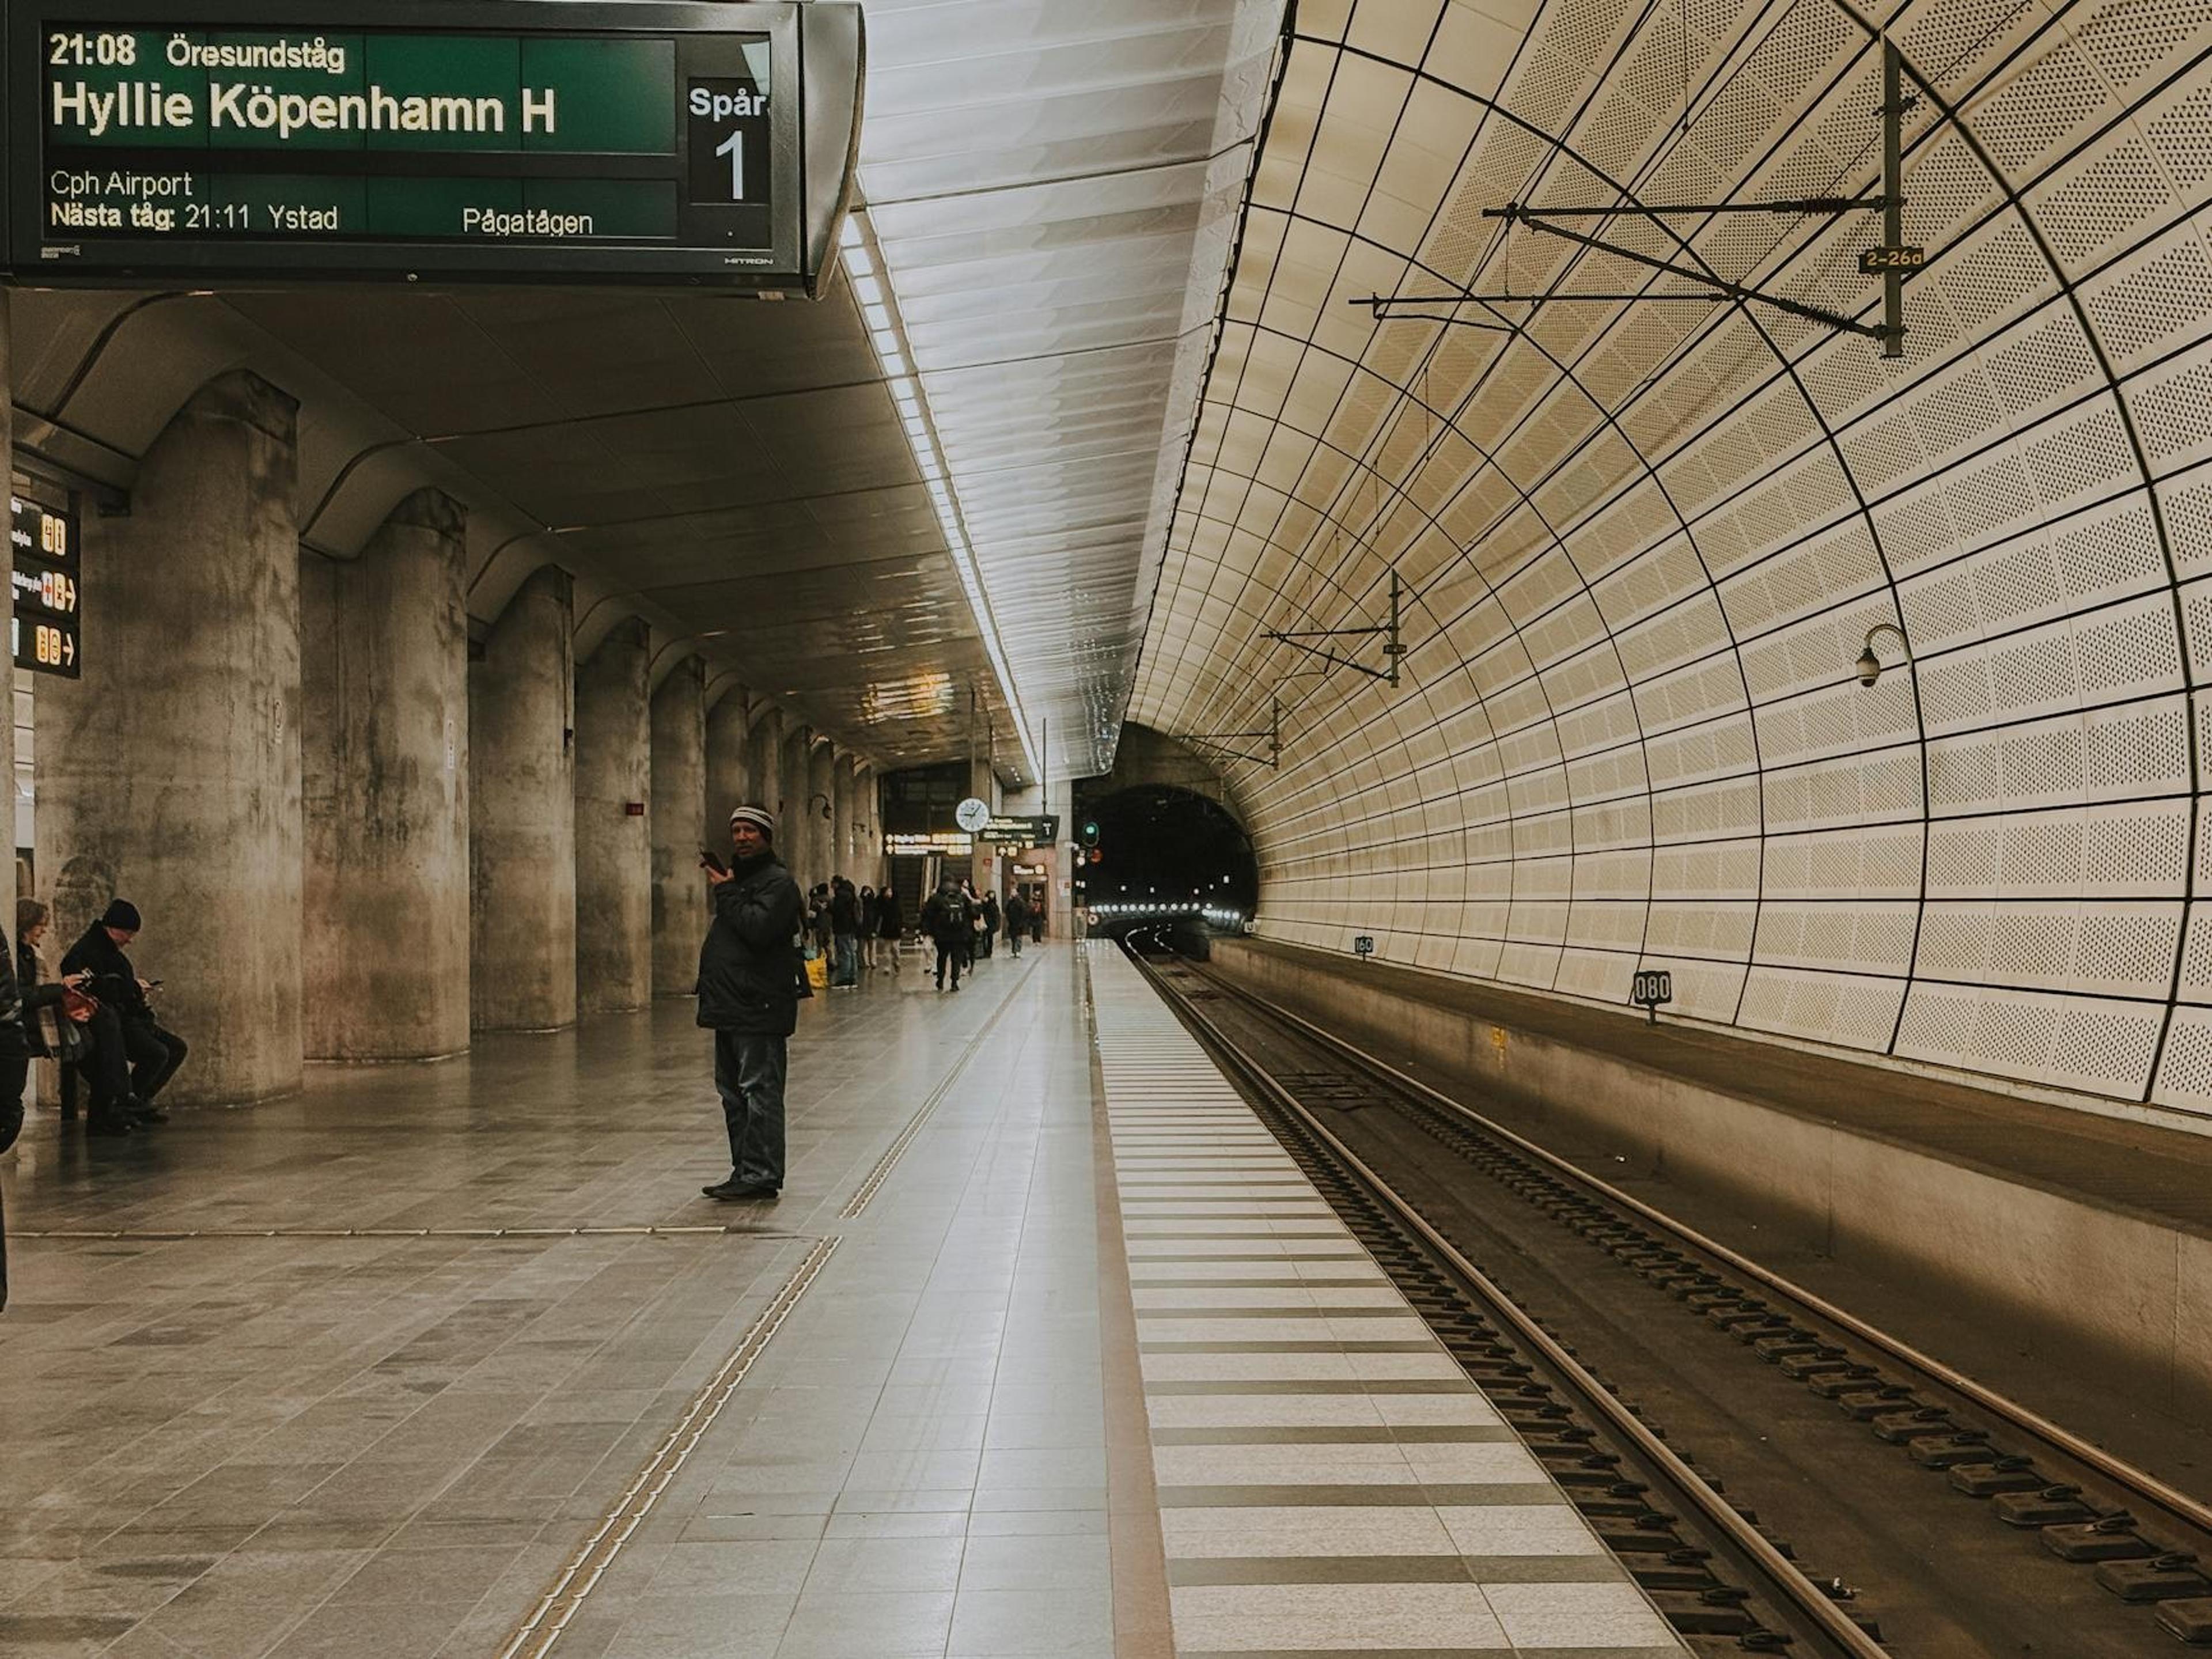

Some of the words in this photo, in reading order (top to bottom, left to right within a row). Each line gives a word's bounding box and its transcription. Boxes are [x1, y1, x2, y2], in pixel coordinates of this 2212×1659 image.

[50, 33, 136, 66] 21:08
[166, 33, 345, 74] Öresundståg
[54, 81, 193, 136] Hyllie
[210, 83, 503, 139] Köpenhamn
[522, 88, 555, 133] H
[689, 88, 766, 122] Spår
[716, 131, 743, 199] 1
[51, 171, 99, 199] Cph
[104, 171, 193, 200] Airport
[51, 202, 123, 227] Nästa
[130, 201, 176, 232] tåg:
[185, 203, 248, 229] 21:11
[268, 204, 338, 230] Ystad
[463, 207, 593, 237] Pågatågen
[1866, 251, 1922, 266] 2-26a
[1636, 975, 1669, 999] 080
